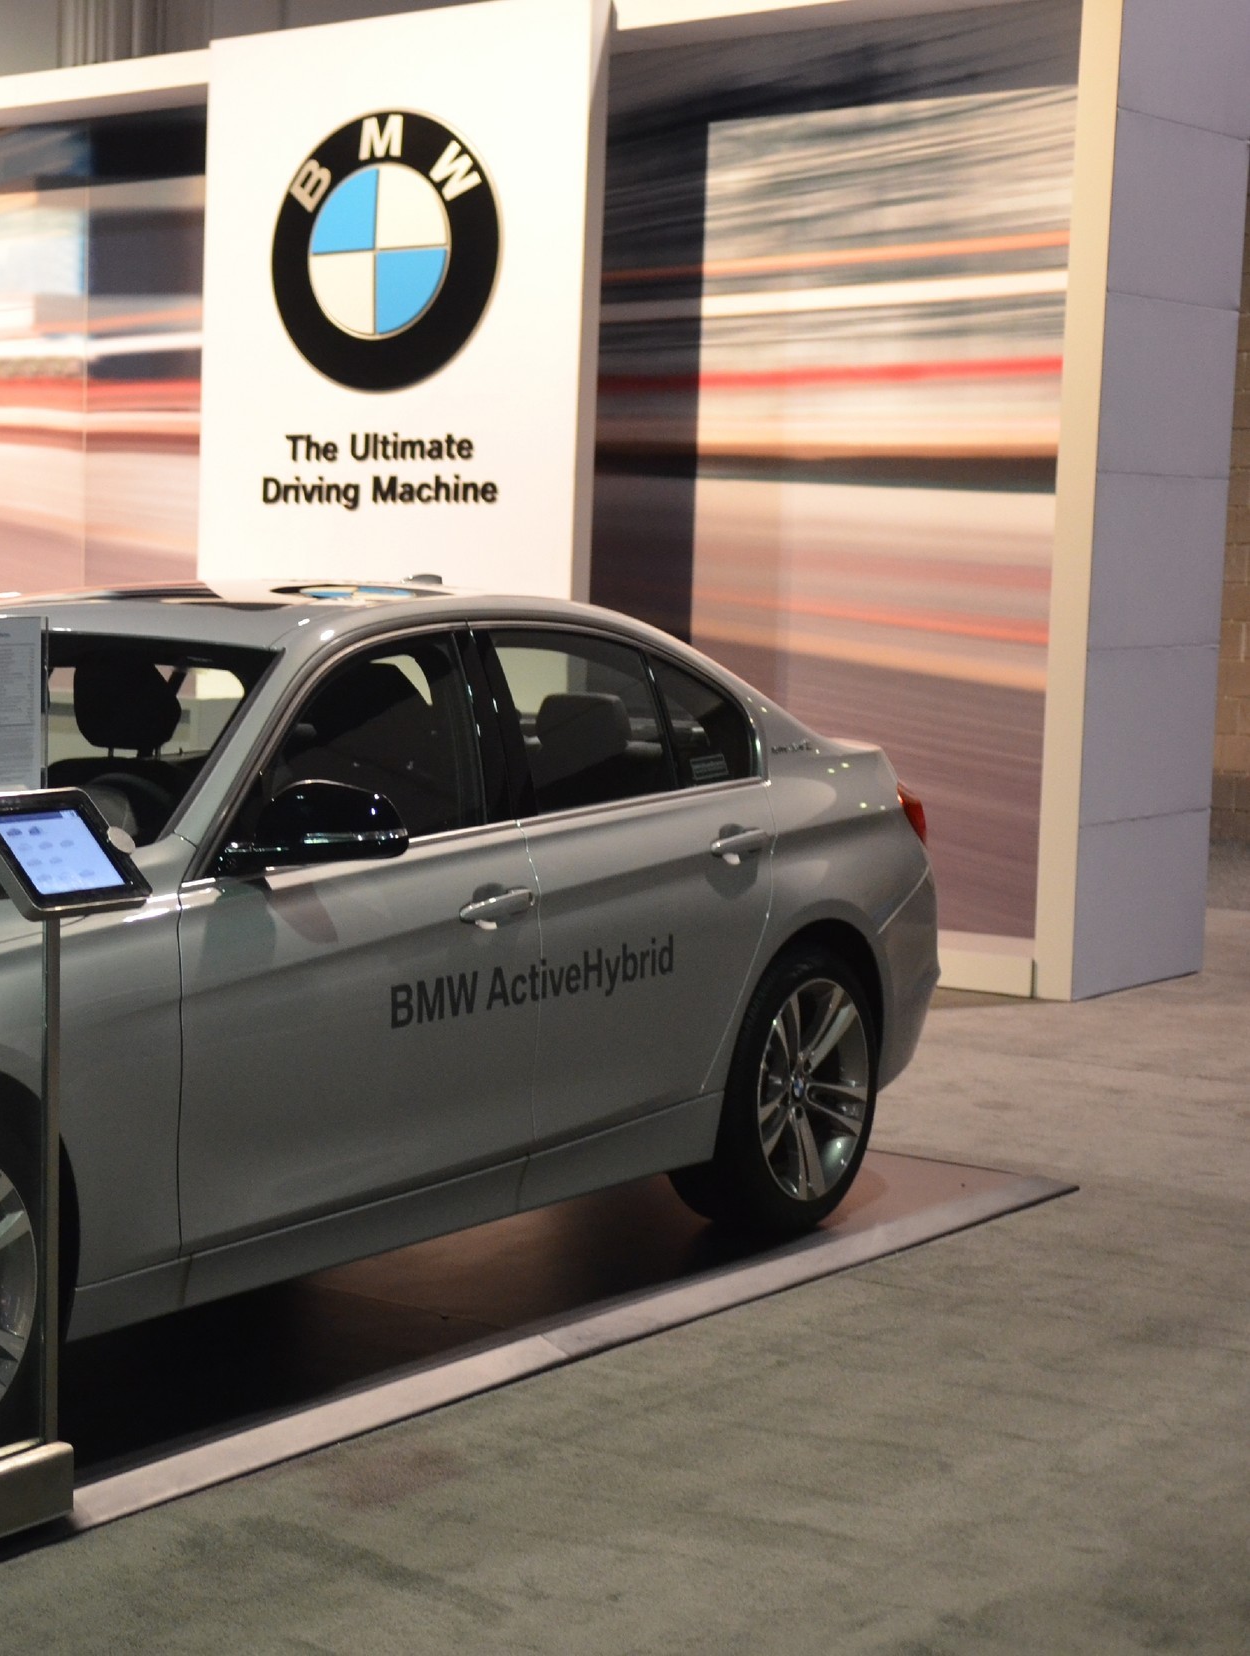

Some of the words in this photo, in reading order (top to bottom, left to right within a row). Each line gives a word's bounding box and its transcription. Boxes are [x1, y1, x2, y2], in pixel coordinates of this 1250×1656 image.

[289, 114, 482, 214] BMW
[285, 434, 338, 462] The
[349, 432, 475, 462] Ultimate
[262, 475, 360, 510] Driving
[371, 474, 499, 504] Machine
[390, 970, 479, 1029] BMW
[486, 933, 674, 1011] ActiveHybrid
